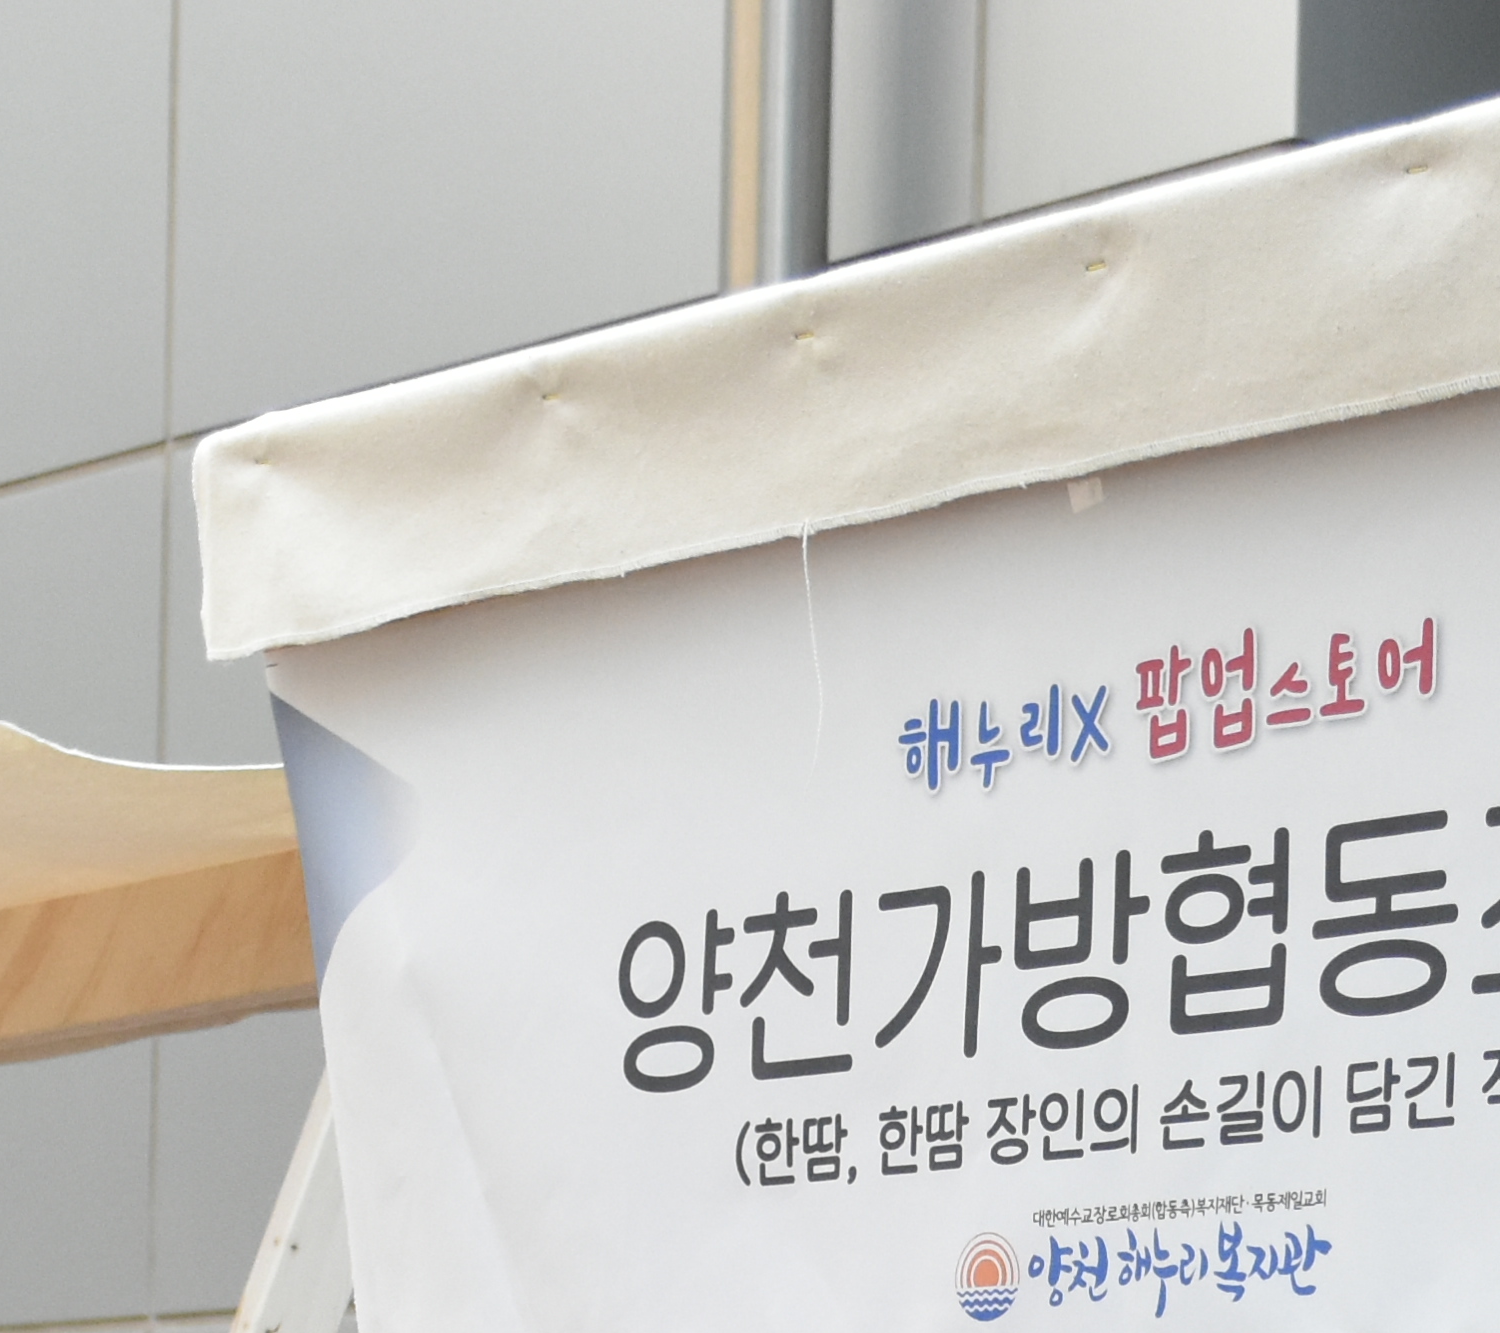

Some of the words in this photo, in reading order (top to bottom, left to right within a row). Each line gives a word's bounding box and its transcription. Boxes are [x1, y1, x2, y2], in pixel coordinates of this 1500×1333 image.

[1135, 616, 1436, 761] 팝업스토어
[734, 1115, 859, 1188] (한땀,
[878, 1100, 969, 1177] 한땀
[986, 1080, 1142, 1168] 장인의
[1159, 1065, 1323, 1152] 손길이
[1346, 1050, 1457, 1135] 담긴
